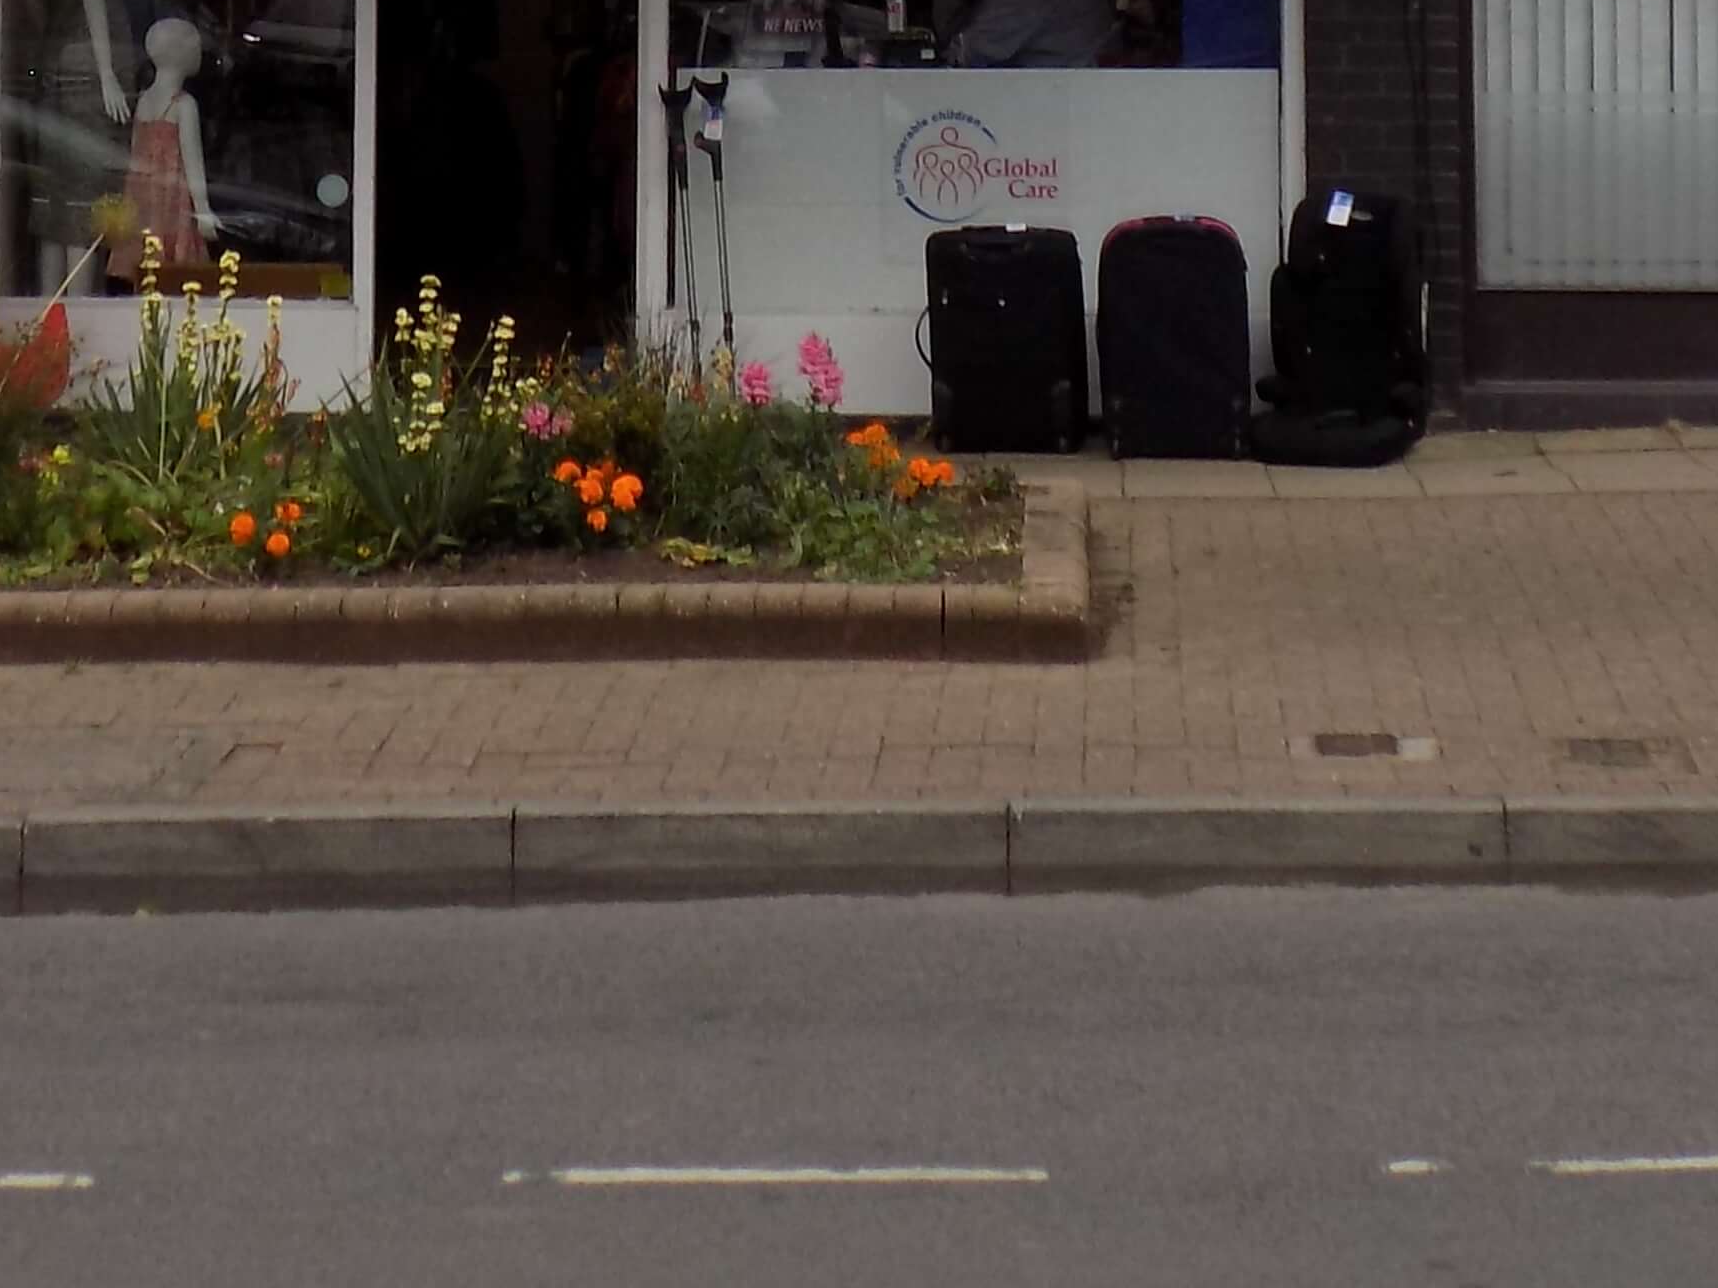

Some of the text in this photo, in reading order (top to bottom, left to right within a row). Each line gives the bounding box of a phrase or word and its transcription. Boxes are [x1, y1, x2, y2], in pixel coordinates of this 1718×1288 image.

[931, 109, 982, 127] children
[984, 157, 1058, 178] Global
[1007, 179, 1058, 199] Care
